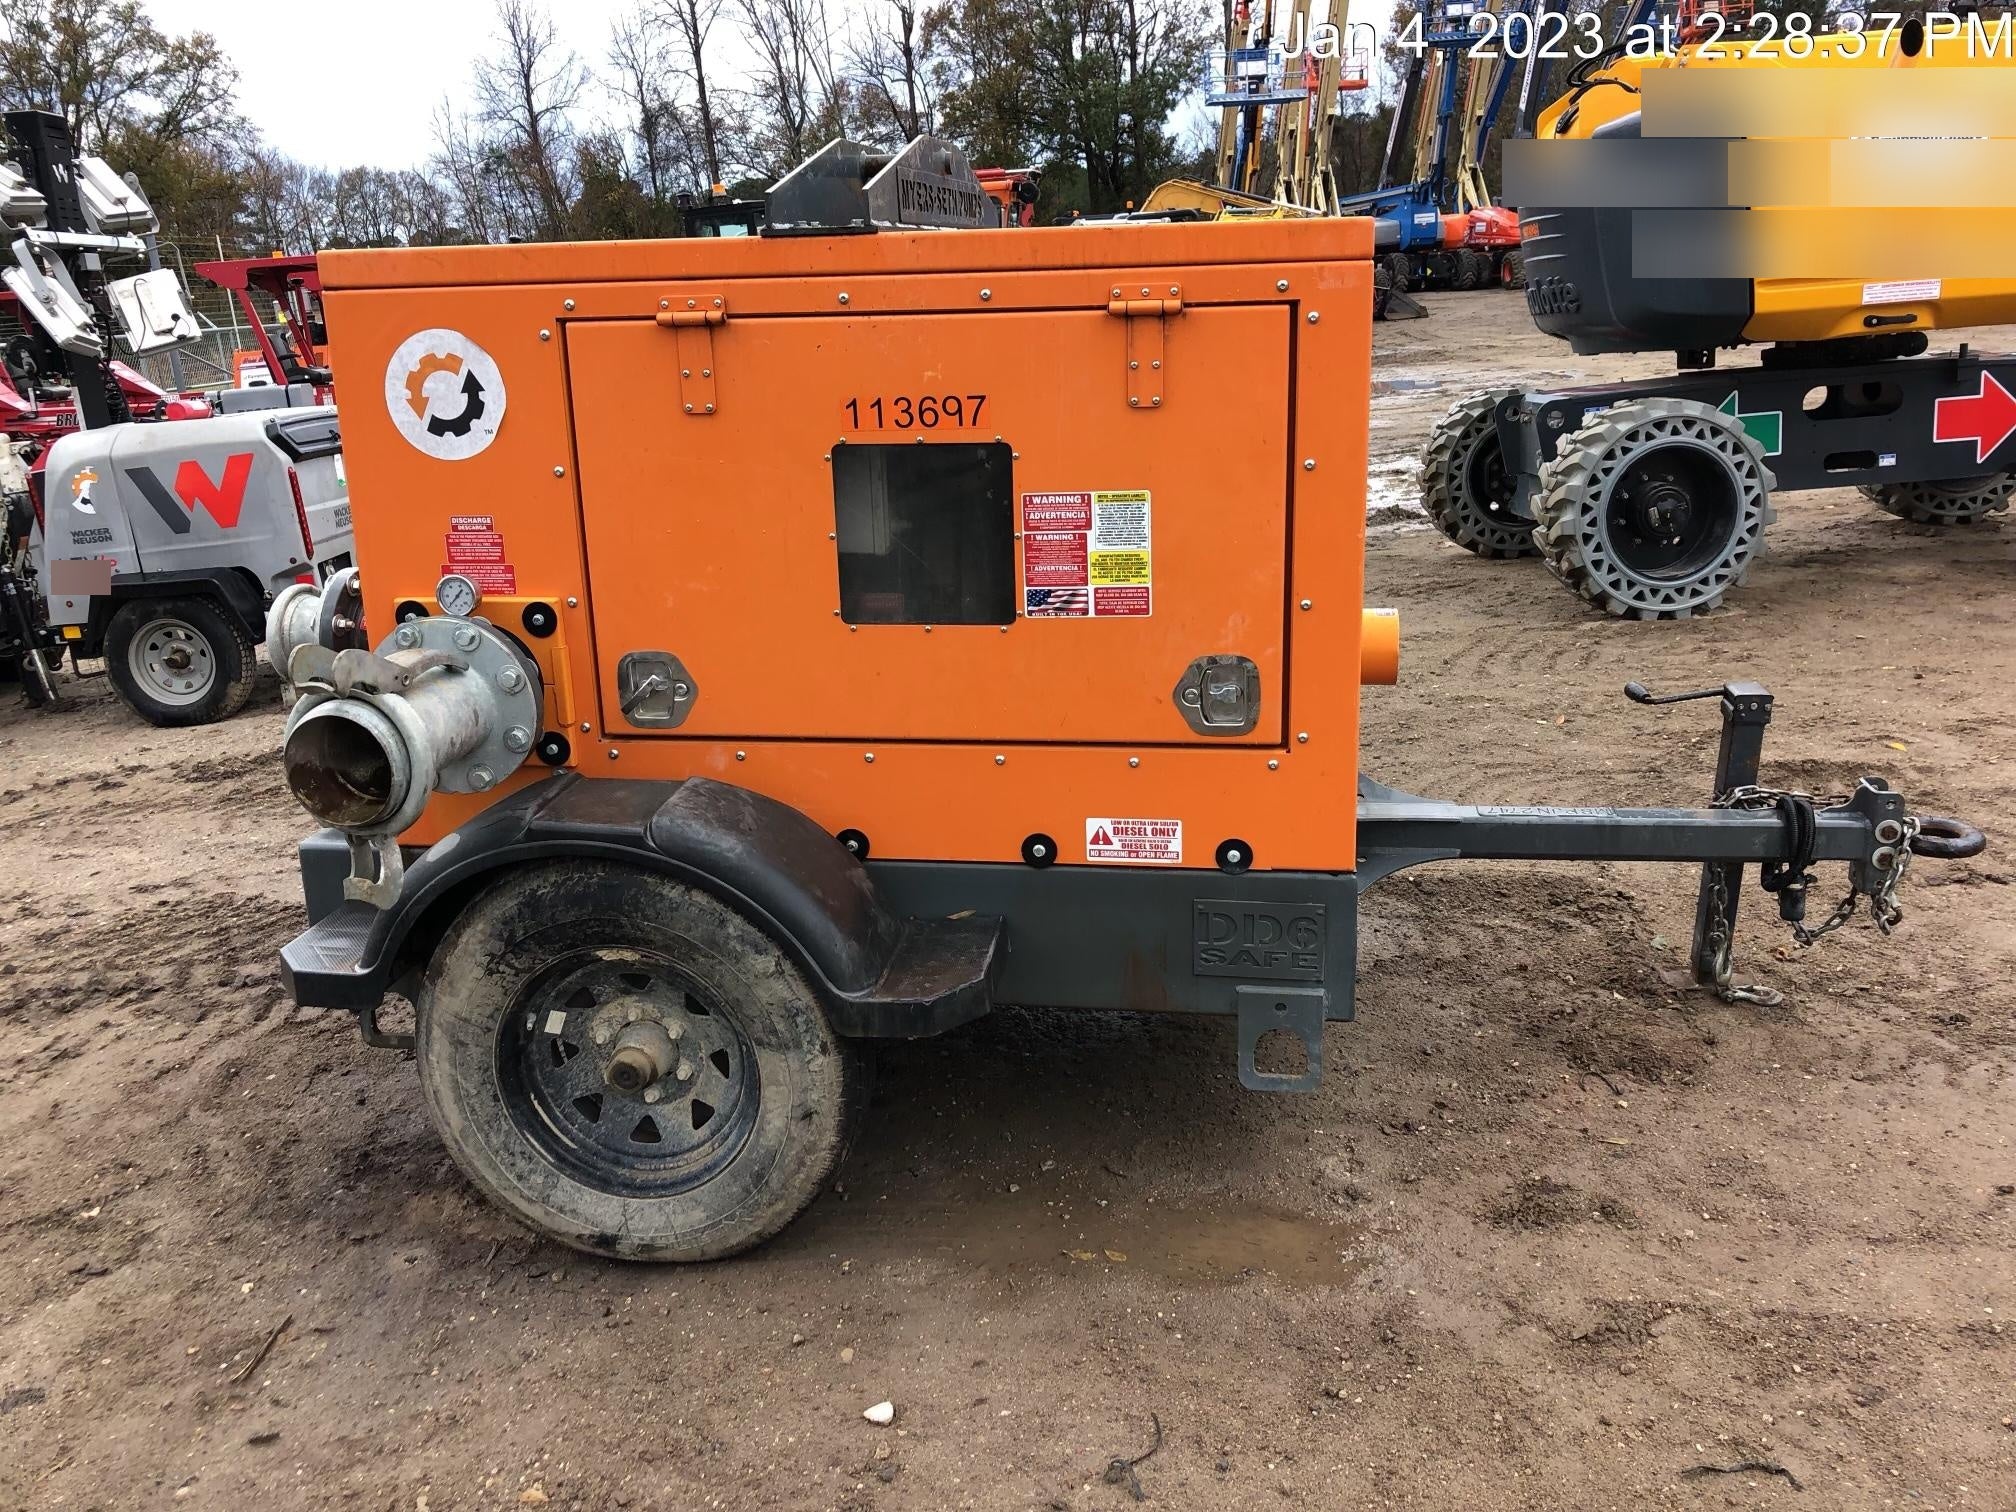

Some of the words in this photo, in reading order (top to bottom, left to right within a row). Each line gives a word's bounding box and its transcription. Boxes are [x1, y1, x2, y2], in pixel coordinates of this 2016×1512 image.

[845, 394, 987, 430] 113697
[1032, 495, 1082, 504] WARNING
[1029, 511, 1086, 520] ADVERTENCIA
[70, 527, 111, 538] WACKER
[72, 535, 113, 545] NEUSON
[1113, 826, 1148, 836] DIESEL
[1151, 827, 1177, 837] ONLY
[1121, 842, 1147, 850] DIESEL
[1100, 850, 1129, 858] SMOKING
[1156, 851, 1178, 859] FLAME
[1197, 911, 1319, 950] DD6
[1200, 948, 1319, 970] SAFE
